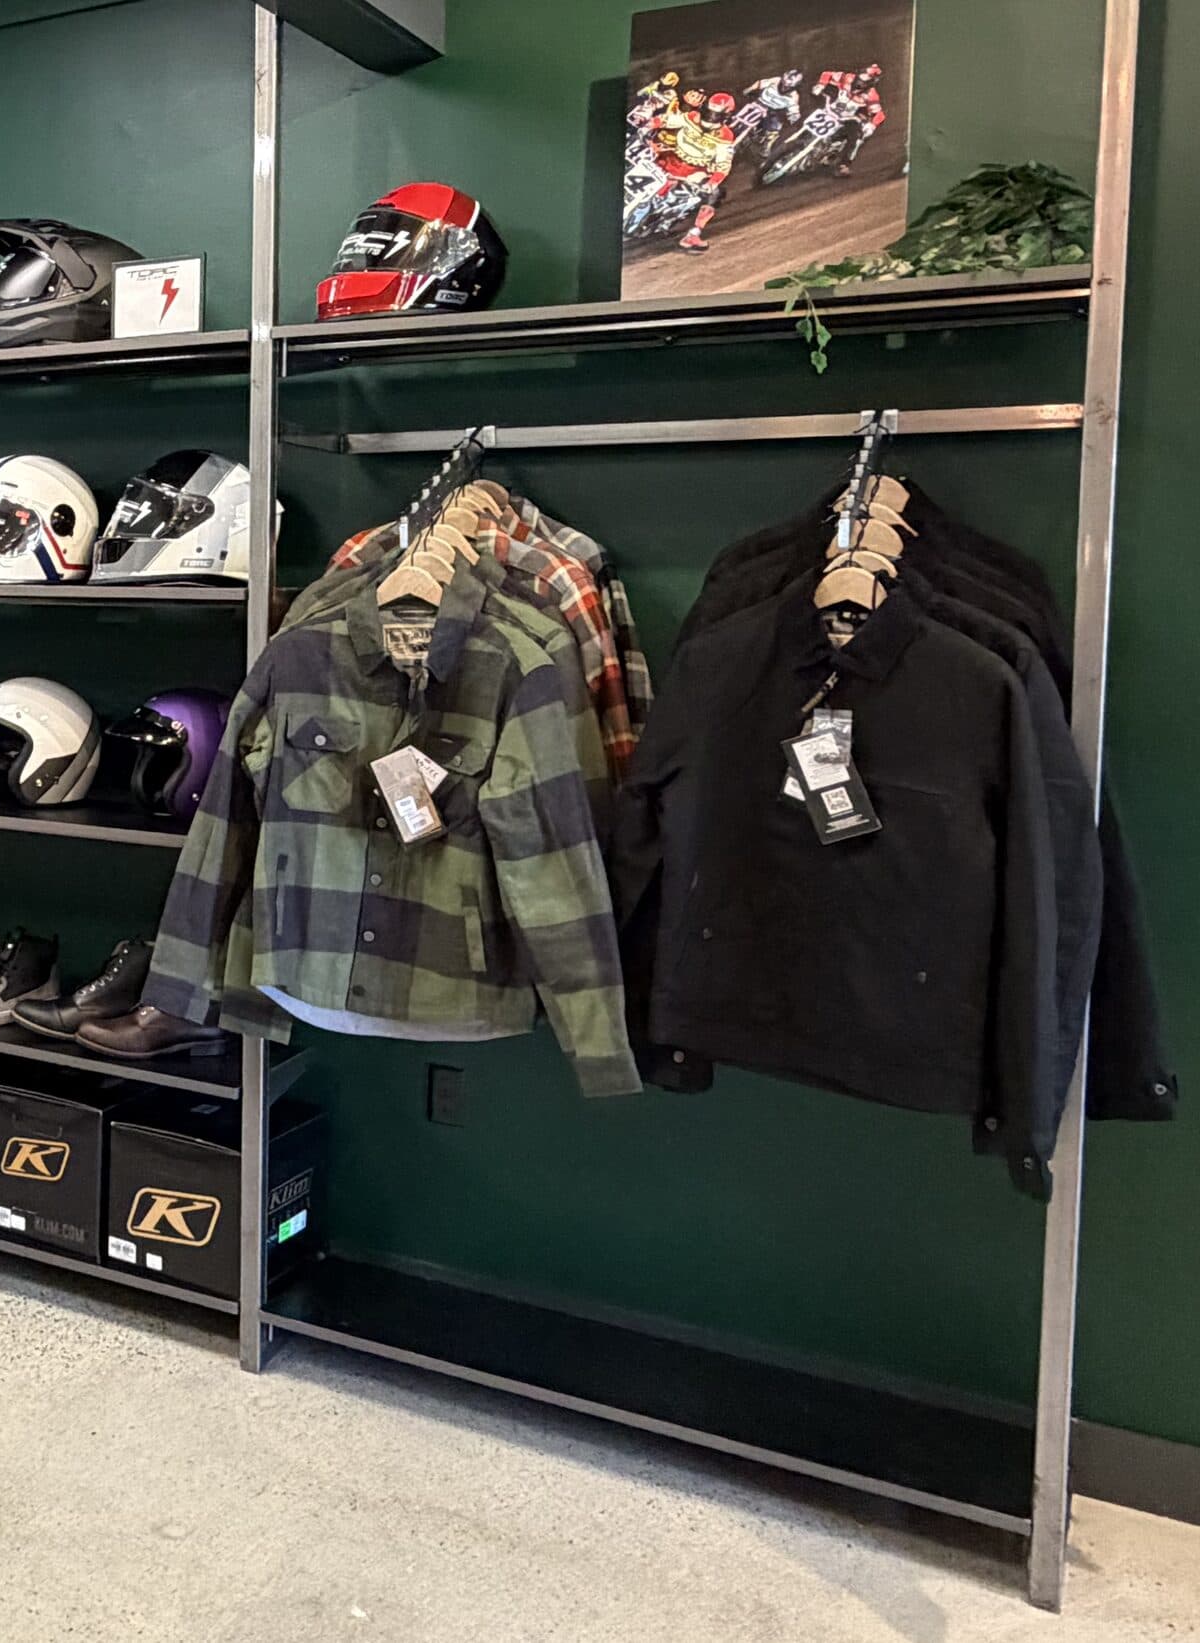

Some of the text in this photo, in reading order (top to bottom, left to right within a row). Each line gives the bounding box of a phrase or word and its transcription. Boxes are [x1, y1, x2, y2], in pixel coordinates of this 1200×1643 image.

[808, 113, 835, 136] 28
[4, 1141, 66, 1177] K
[132, 1194, 214, 1241] K
